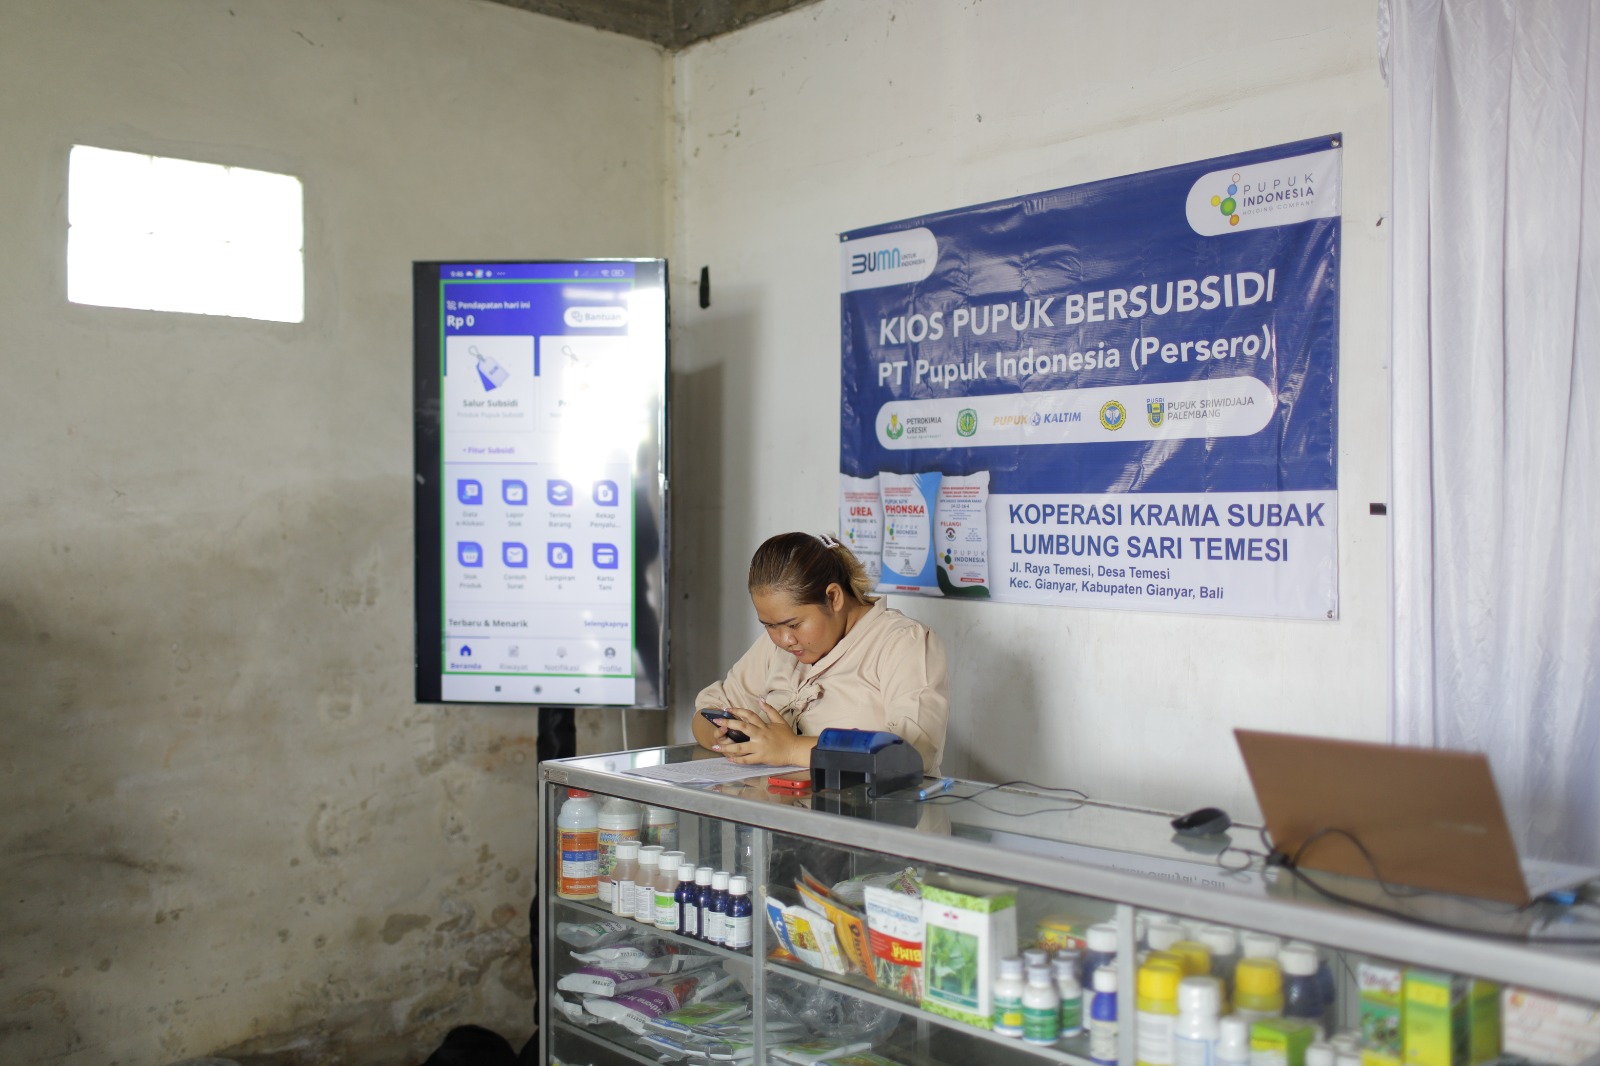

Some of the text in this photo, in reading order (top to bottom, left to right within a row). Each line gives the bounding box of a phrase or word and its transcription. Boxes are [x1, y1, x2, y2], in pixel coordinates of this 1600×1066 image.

[1243, 172, 1314, 195] PUPUK
[1243, 186, 1314, 207] INDONESIA
[1242, 206, 1274, 216] HOLDING
[458, 300, 531, 311] Pendapatan hari ini
[879, 268, 1275, 346] KIOS PUPUK BERSUBSIDI
[584, 312, 622, 321] Bantuan
[446, 314, 475, 330] Rp 0
[878, 324, 1271, 389] PT Pupuk Indonesia (Persero)
[462, 399, 518, 408] Salur Subsidi
[1167, 396, 1255, 411] PUPUK SRIWIDJAJA
[993, 412, 1081, 426] PUPUK KALTIM
[1167, 409, 1221, 421] PALEMBANG
[906, 416, 942, 425] PETROKIMIA
[906, 426, 927, 435] GRESIK
[487, 446, 515, 454] Subsidi
[850, 506, 873, 516] UREA
[885, 504, 925, 514] PHONSKA
[1009, 503, 1122, 526] KOPERASI
[1130, 503, 1220, 527] KRAMA
[1227, 502, 1325, 527] SUBAK
[548, 521, 572, 529] Barang
[1010, 533, 1119, 557] LUMBUNG
[1126, 535, 1182, 559] SARI
[1190, 537, 1288, 562] TEMESI
[1010, 562, 1170, 580] Jl. Raya Temesi, Desa Temesi
[1010, 577, 1224, 600] Kec. Gianyar, Kabupaten Gianyar, Bali
[448, 618, 528, 628] Terbaru & Menarik
[583, 620, 629, 629] Selengkapnya
[544, 664, 580, 672] Notifikasi
[598, 664, 623, 673] Profile
